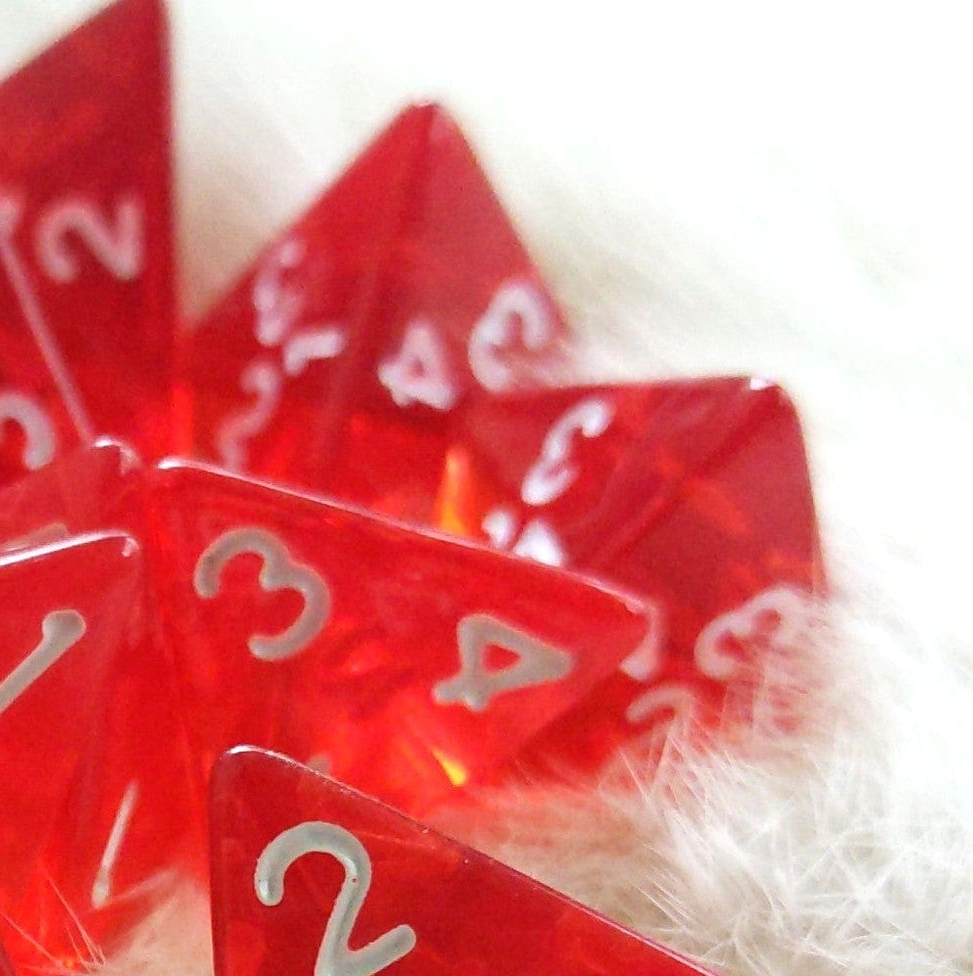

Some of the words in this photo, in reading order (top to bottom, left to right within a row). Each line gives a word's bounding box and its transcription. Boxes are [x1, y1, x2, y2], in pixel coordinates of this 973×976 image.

[35, 196, 145, 284] 2
[377, 320, 457, 411] 4
[194, 527, 327, 660] 3
[433, 613, 575, 712] 4
